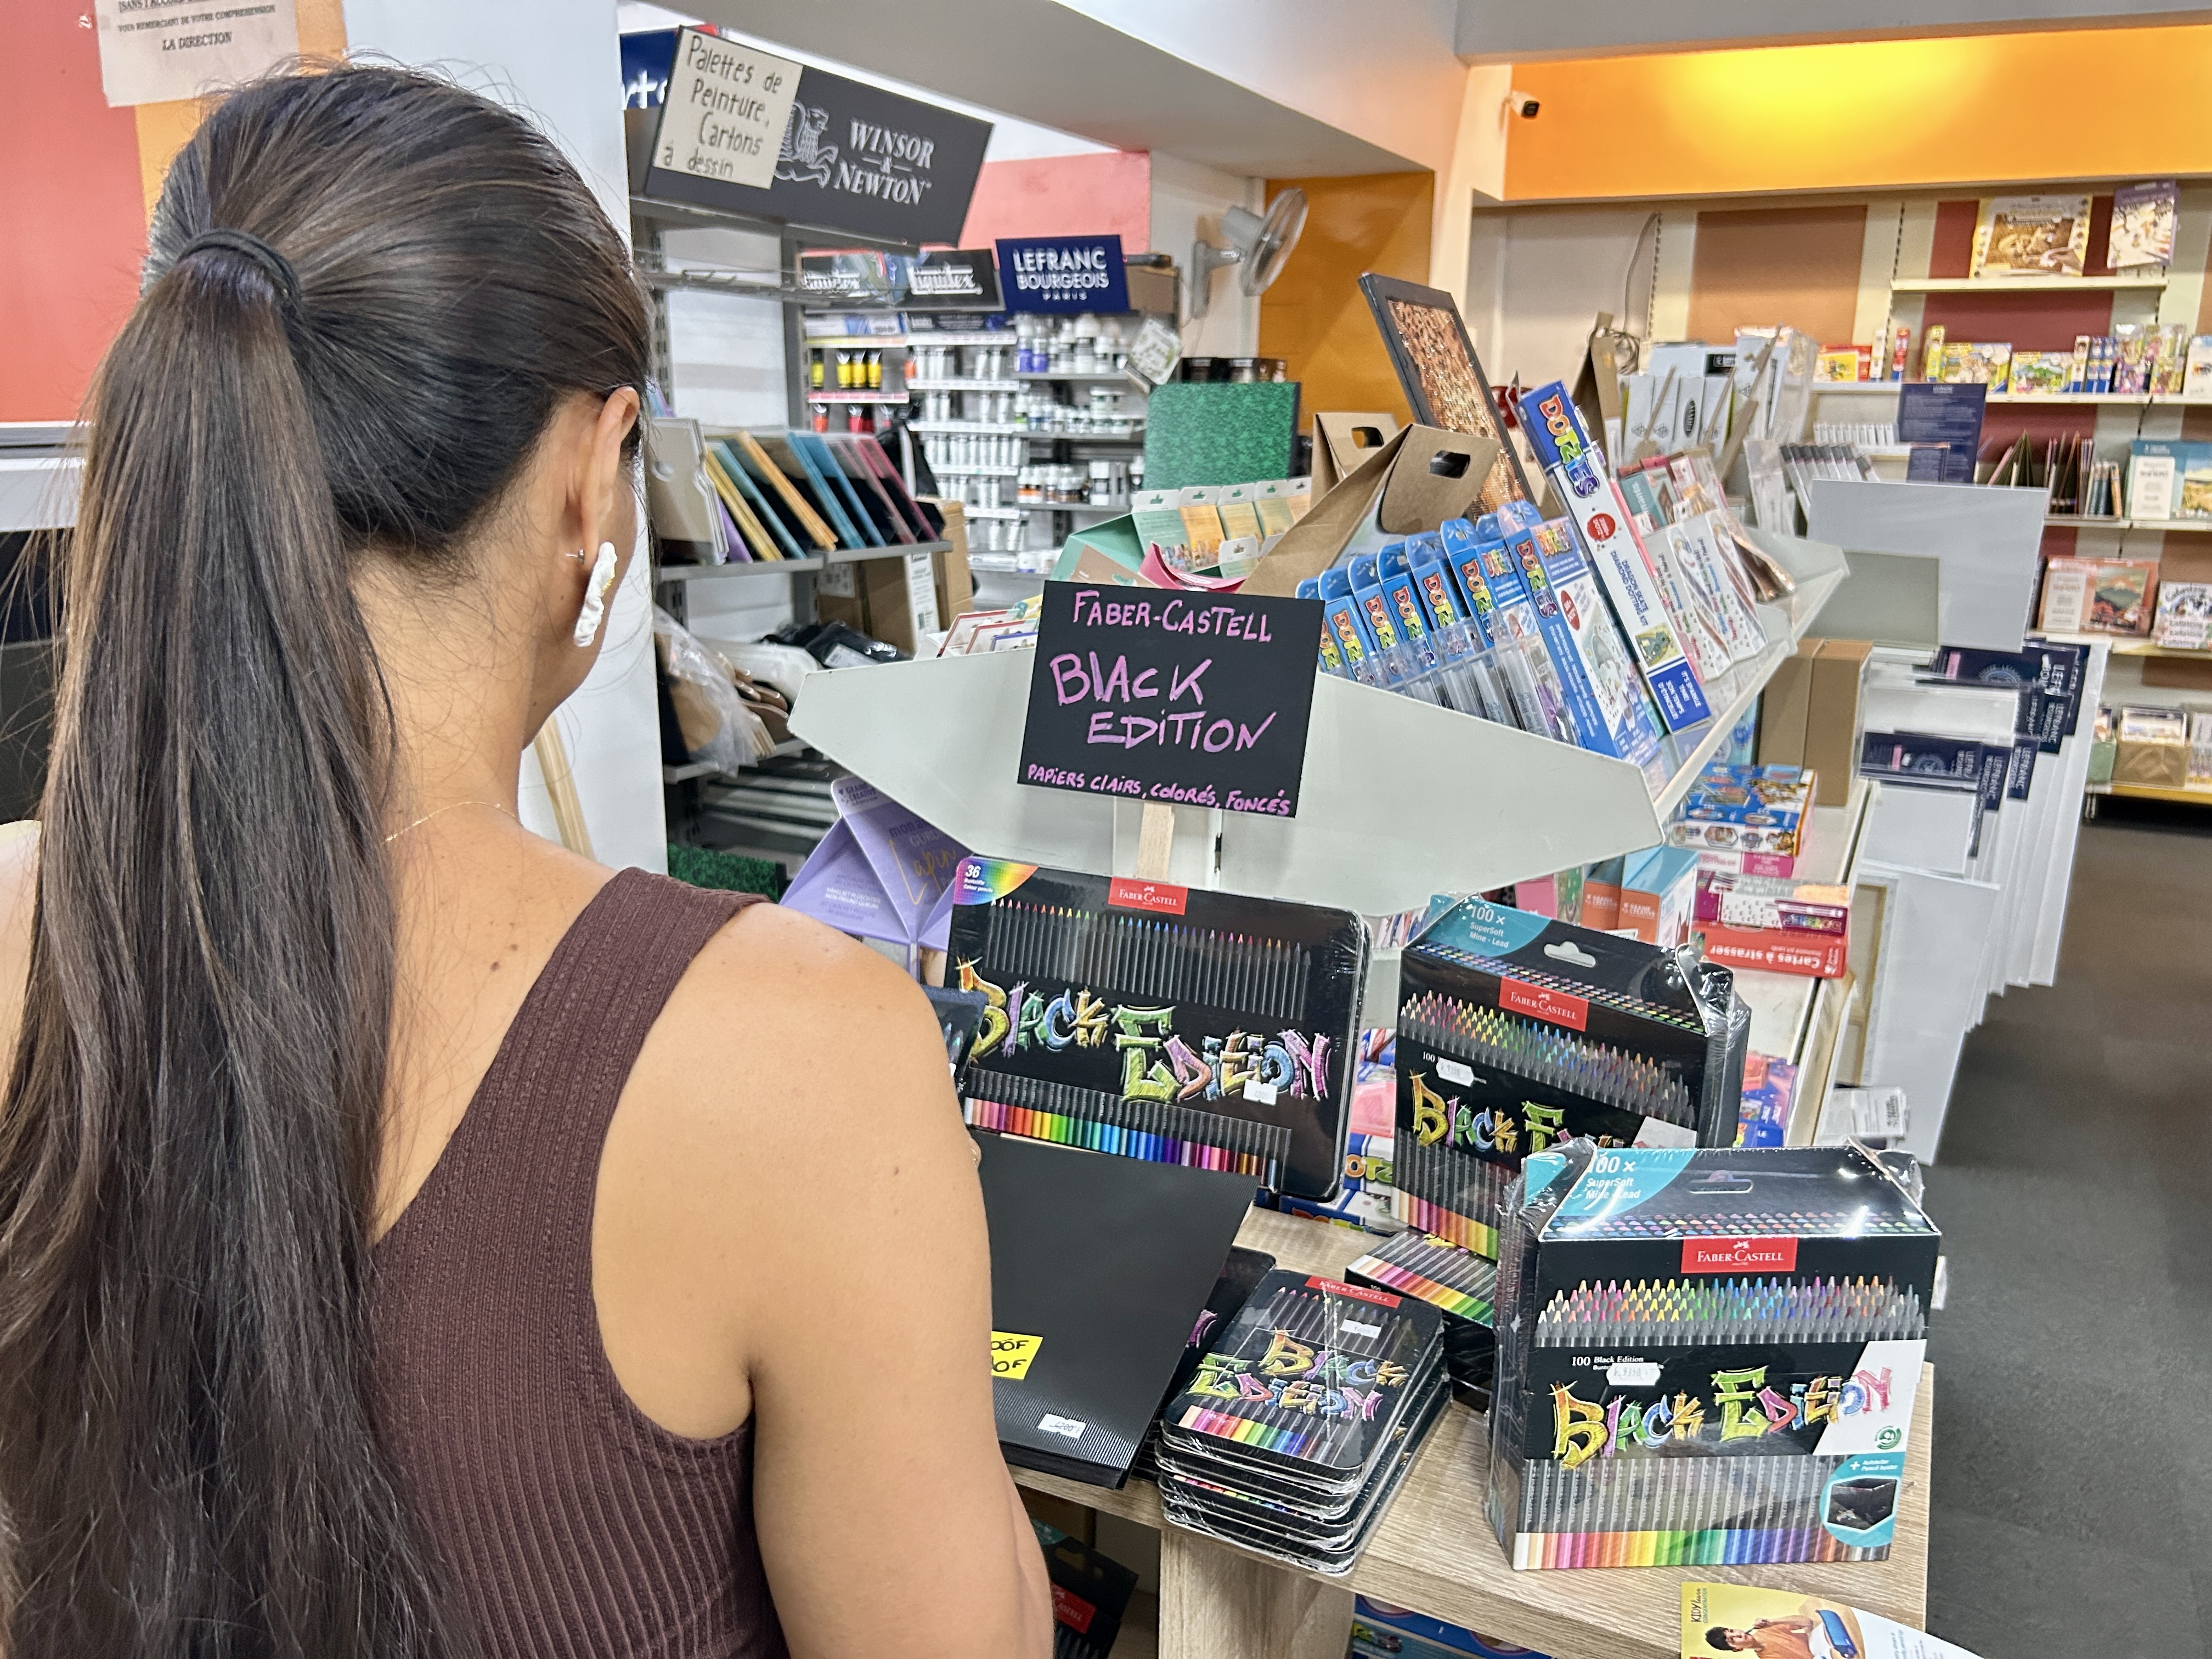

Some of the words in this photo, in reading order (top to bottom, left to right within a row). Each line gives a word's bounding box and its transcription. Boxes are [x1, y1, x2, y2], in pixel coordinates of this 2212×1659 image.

[162, 39, 176, 50] LA
[178, 31, 232, 49] DIRECTION
[686, 34, 755, 84] Palettes
[763, 69, 782, 95] de
[698, 112, 764, 156] Cartons
[850, 117, 934, 170] WINSOR
[687, 145, 734, 178] dessin
[834, 159, 928, 206] NEWTON
[1012, 248, 1107, 272] LEFRANC
[1016, 271, 1109, 290] BOURGEOIS
[1042, 289, 1088, 301] PARIS
[1539, 394, 1600, 498] DOTZIES
[1073, 590, 1272, 642] FABER-CASTELL
[1087, 709, 1277, 753] EDITION
[1028, 763, 1086, 788] PAPIERS
[965, 865, 981, 878] 36
[1470, 905, 1494, 922] 100
[1470, 922, 1504, 937] SuperSoft
[1469, 932, 1487, 943] Mine
[1492, 937, 1509, 949] Lead
[1709, 944, 1764, 961] strasser
[1765, 952, 1775, 964] à
[1778, 953, 1821, 969] Cartes
[1423, 1051, 1435, 1063] 100
[1586, 1177, 1634, 1189] SuperSoft
[1696, 1249, 1785, 1263] FABER-CASTELL
[1571, 1356, 1591, 1366] 100
[1690, 1602, 1702, 1622] KIDY
